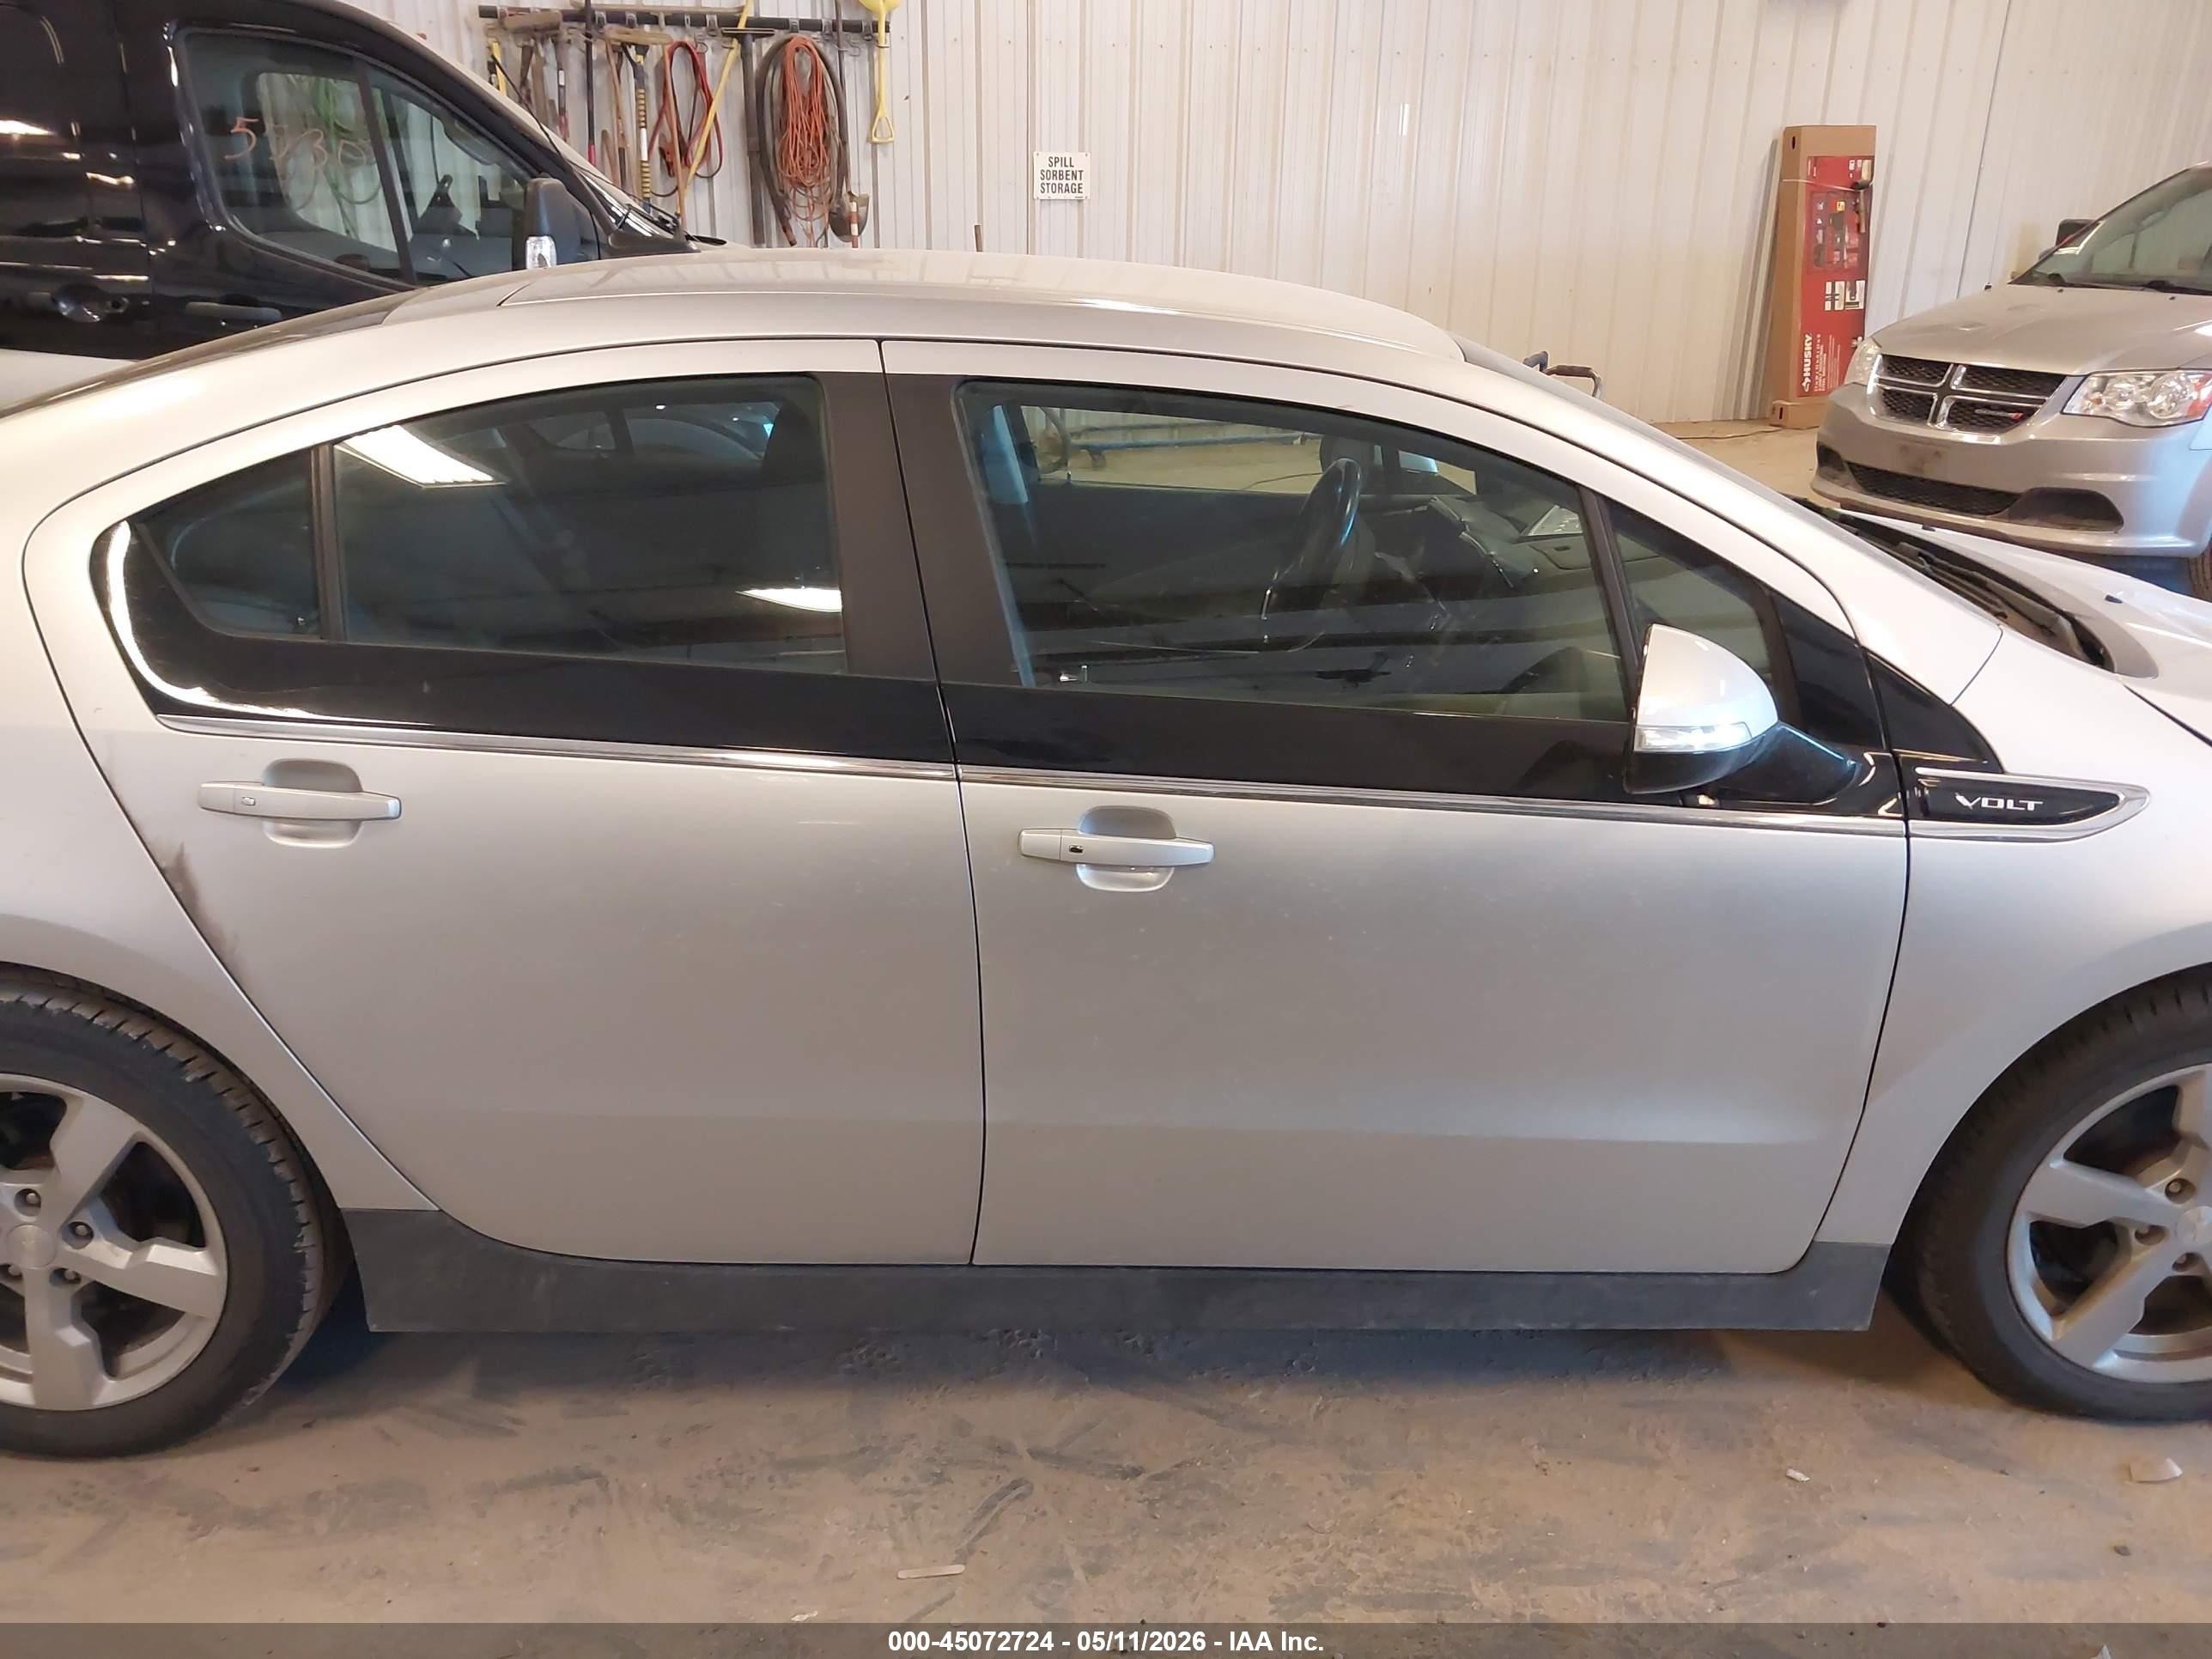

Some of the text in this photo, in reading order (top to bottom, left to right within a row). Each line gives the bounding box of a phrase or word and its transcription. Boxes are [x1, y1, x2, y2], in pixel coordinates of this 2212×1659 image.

[1048, 156, 1074, 167] SPILL
[1040, 169, 1084, 180] SORBENT
[1040, 182, 1084, 194] STORAGE
[1802, 333, 1812, 377] HUSKY
[1954, 793, 2044, 811] VOLT
